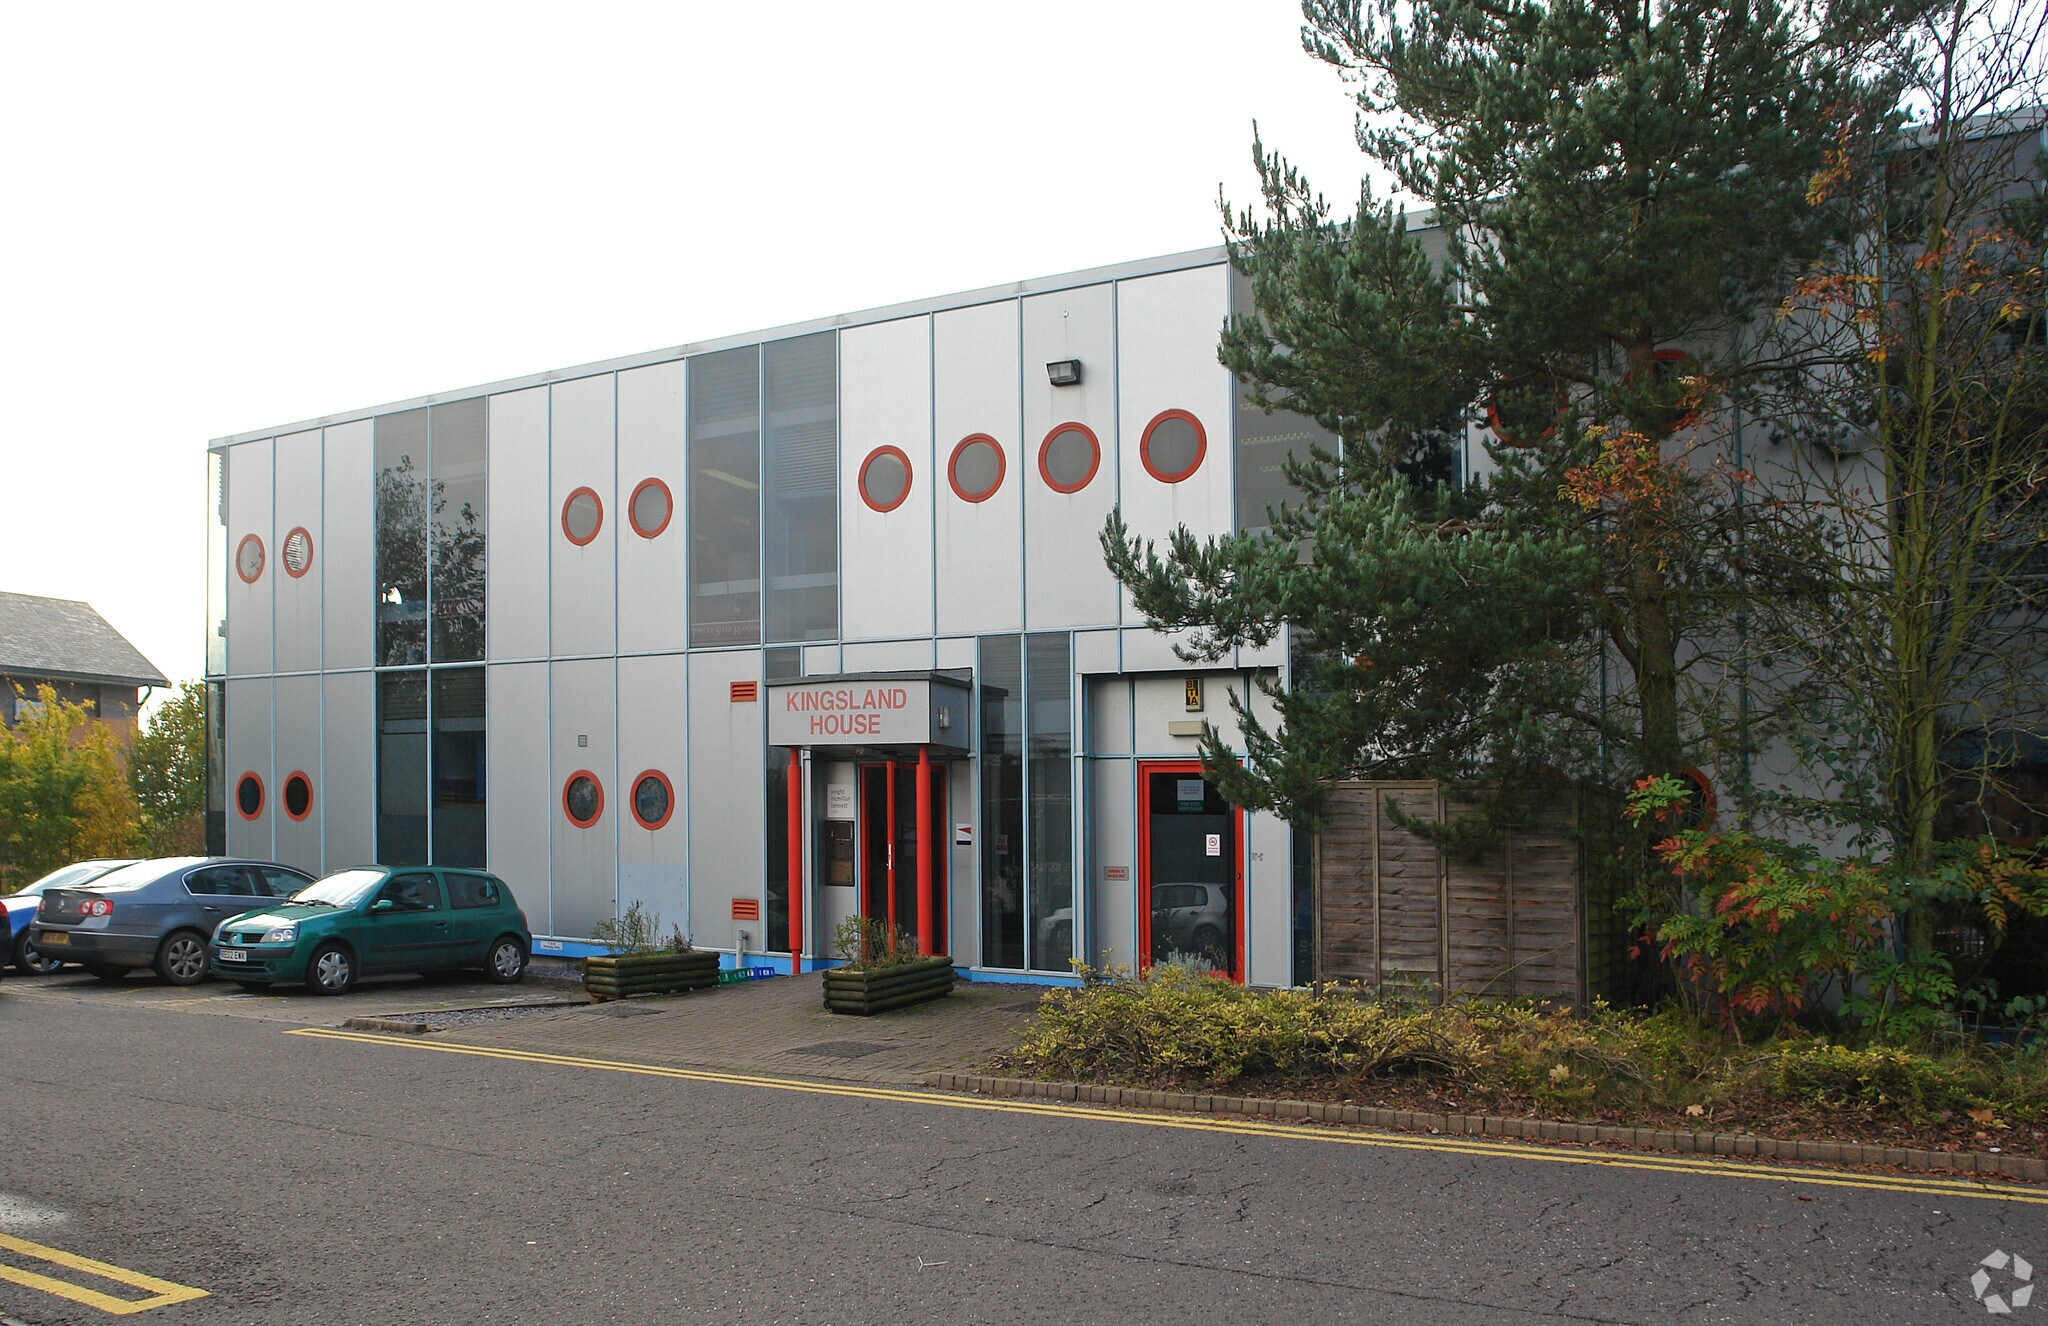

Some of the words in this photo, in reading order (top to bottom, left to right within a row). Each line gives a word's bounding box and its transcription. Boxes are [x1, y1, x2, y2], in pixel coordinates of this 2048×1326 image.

[786, 688, 907, 712] KINGSLAND
[1186, 680, 1199, 705] BTA
[810, 713, 881, 735] HOUSE
